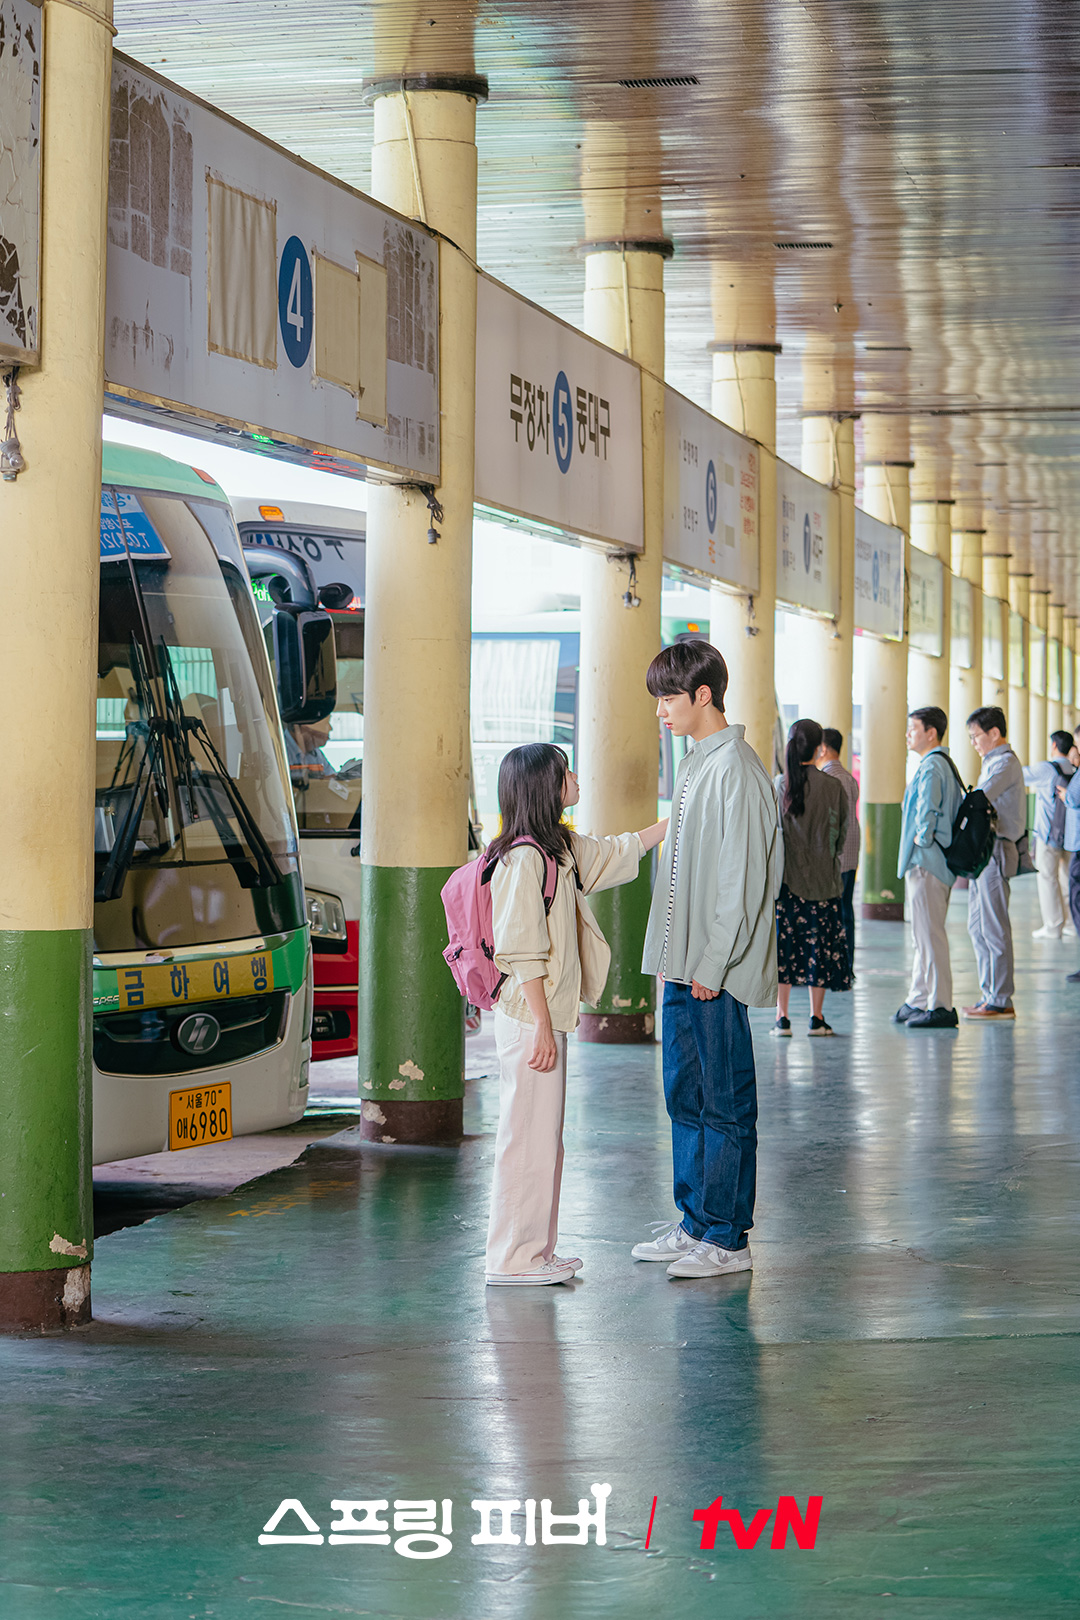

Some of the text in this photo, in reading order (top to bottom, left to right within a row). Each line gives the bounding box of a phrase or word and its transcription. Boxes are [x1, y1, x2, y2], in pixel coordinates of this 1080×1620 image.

[286, 257, 304, 342] 4
[510, 373, 611, 461] 무정차 5 동대구
